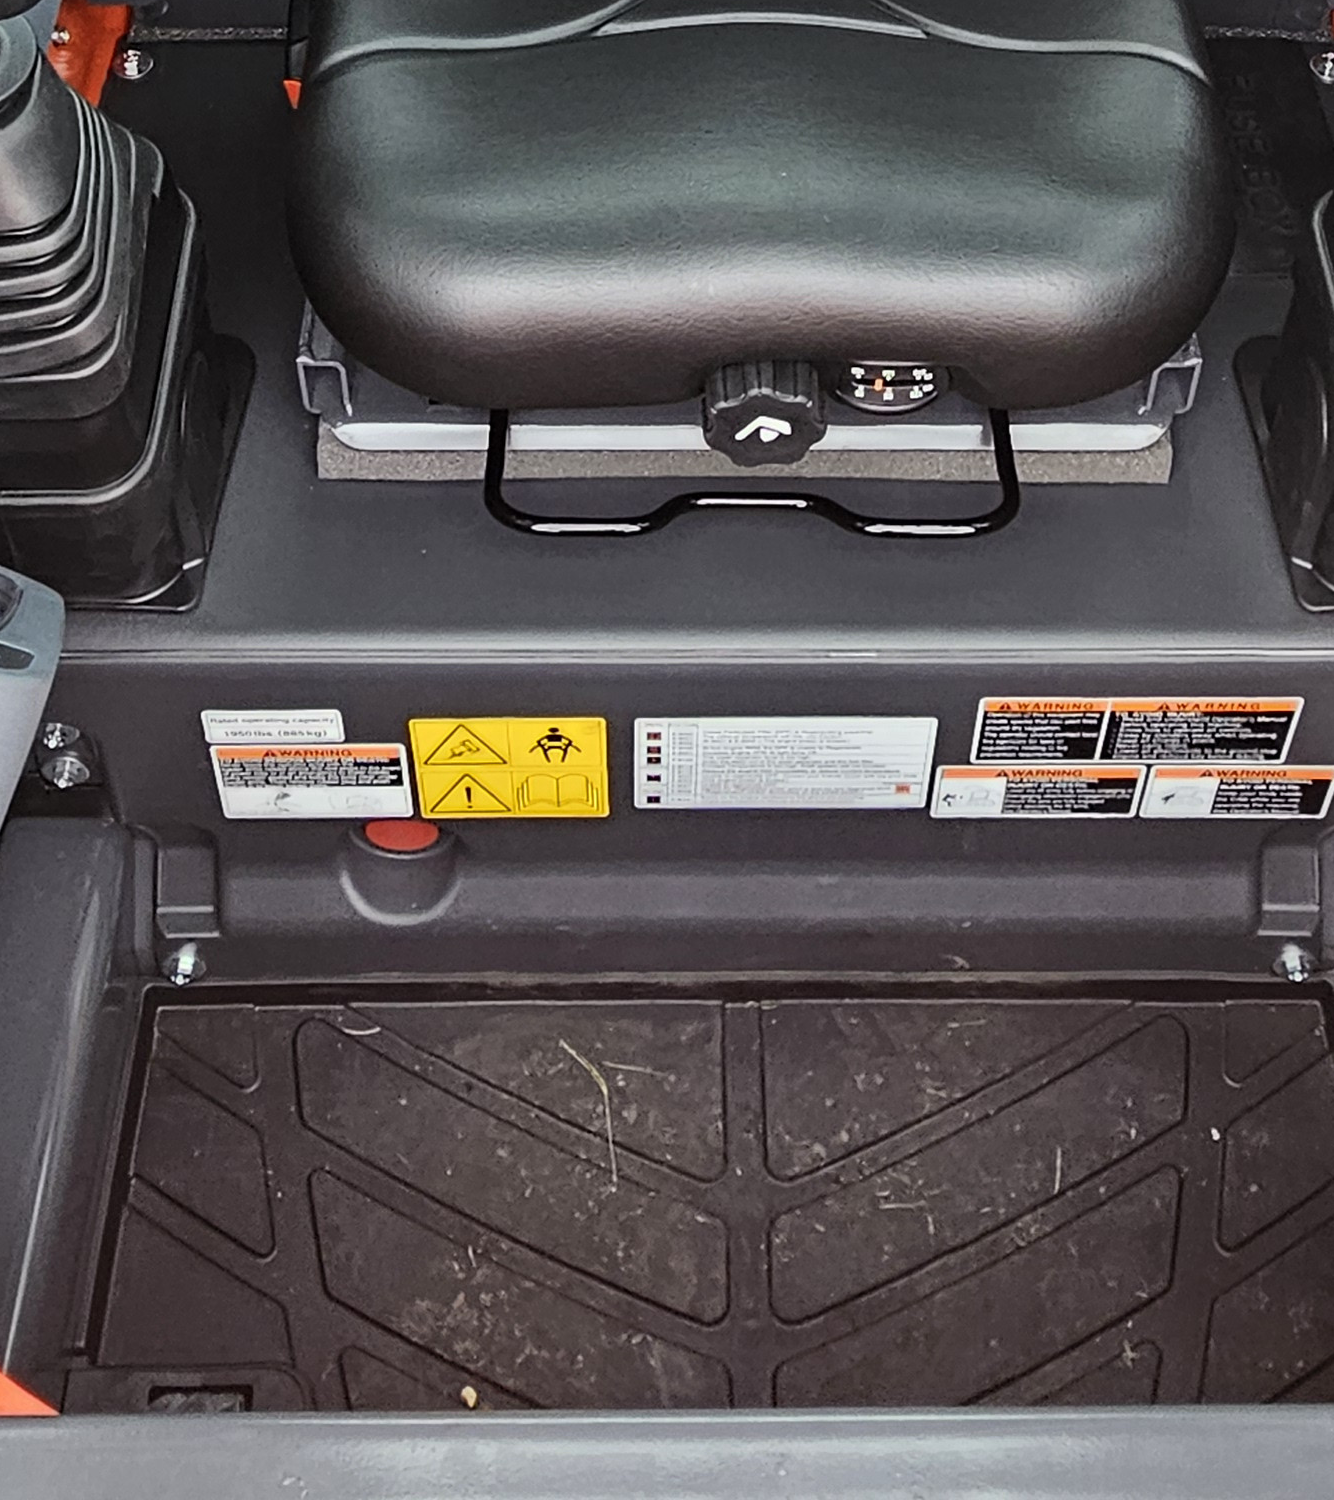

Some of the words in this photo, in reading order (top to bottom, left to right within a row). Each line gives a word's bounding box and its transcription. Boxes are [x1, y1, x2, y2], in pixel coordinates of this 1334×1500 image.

[1017, 702, 1094, 710] WARNING
[1176, 702, 1260, 710] WARNING
[279, 749, 353, 757] WARNING
[1011, 769, 1083, 777] WARNING
[1216, 769, 1288, 777] WARNING
